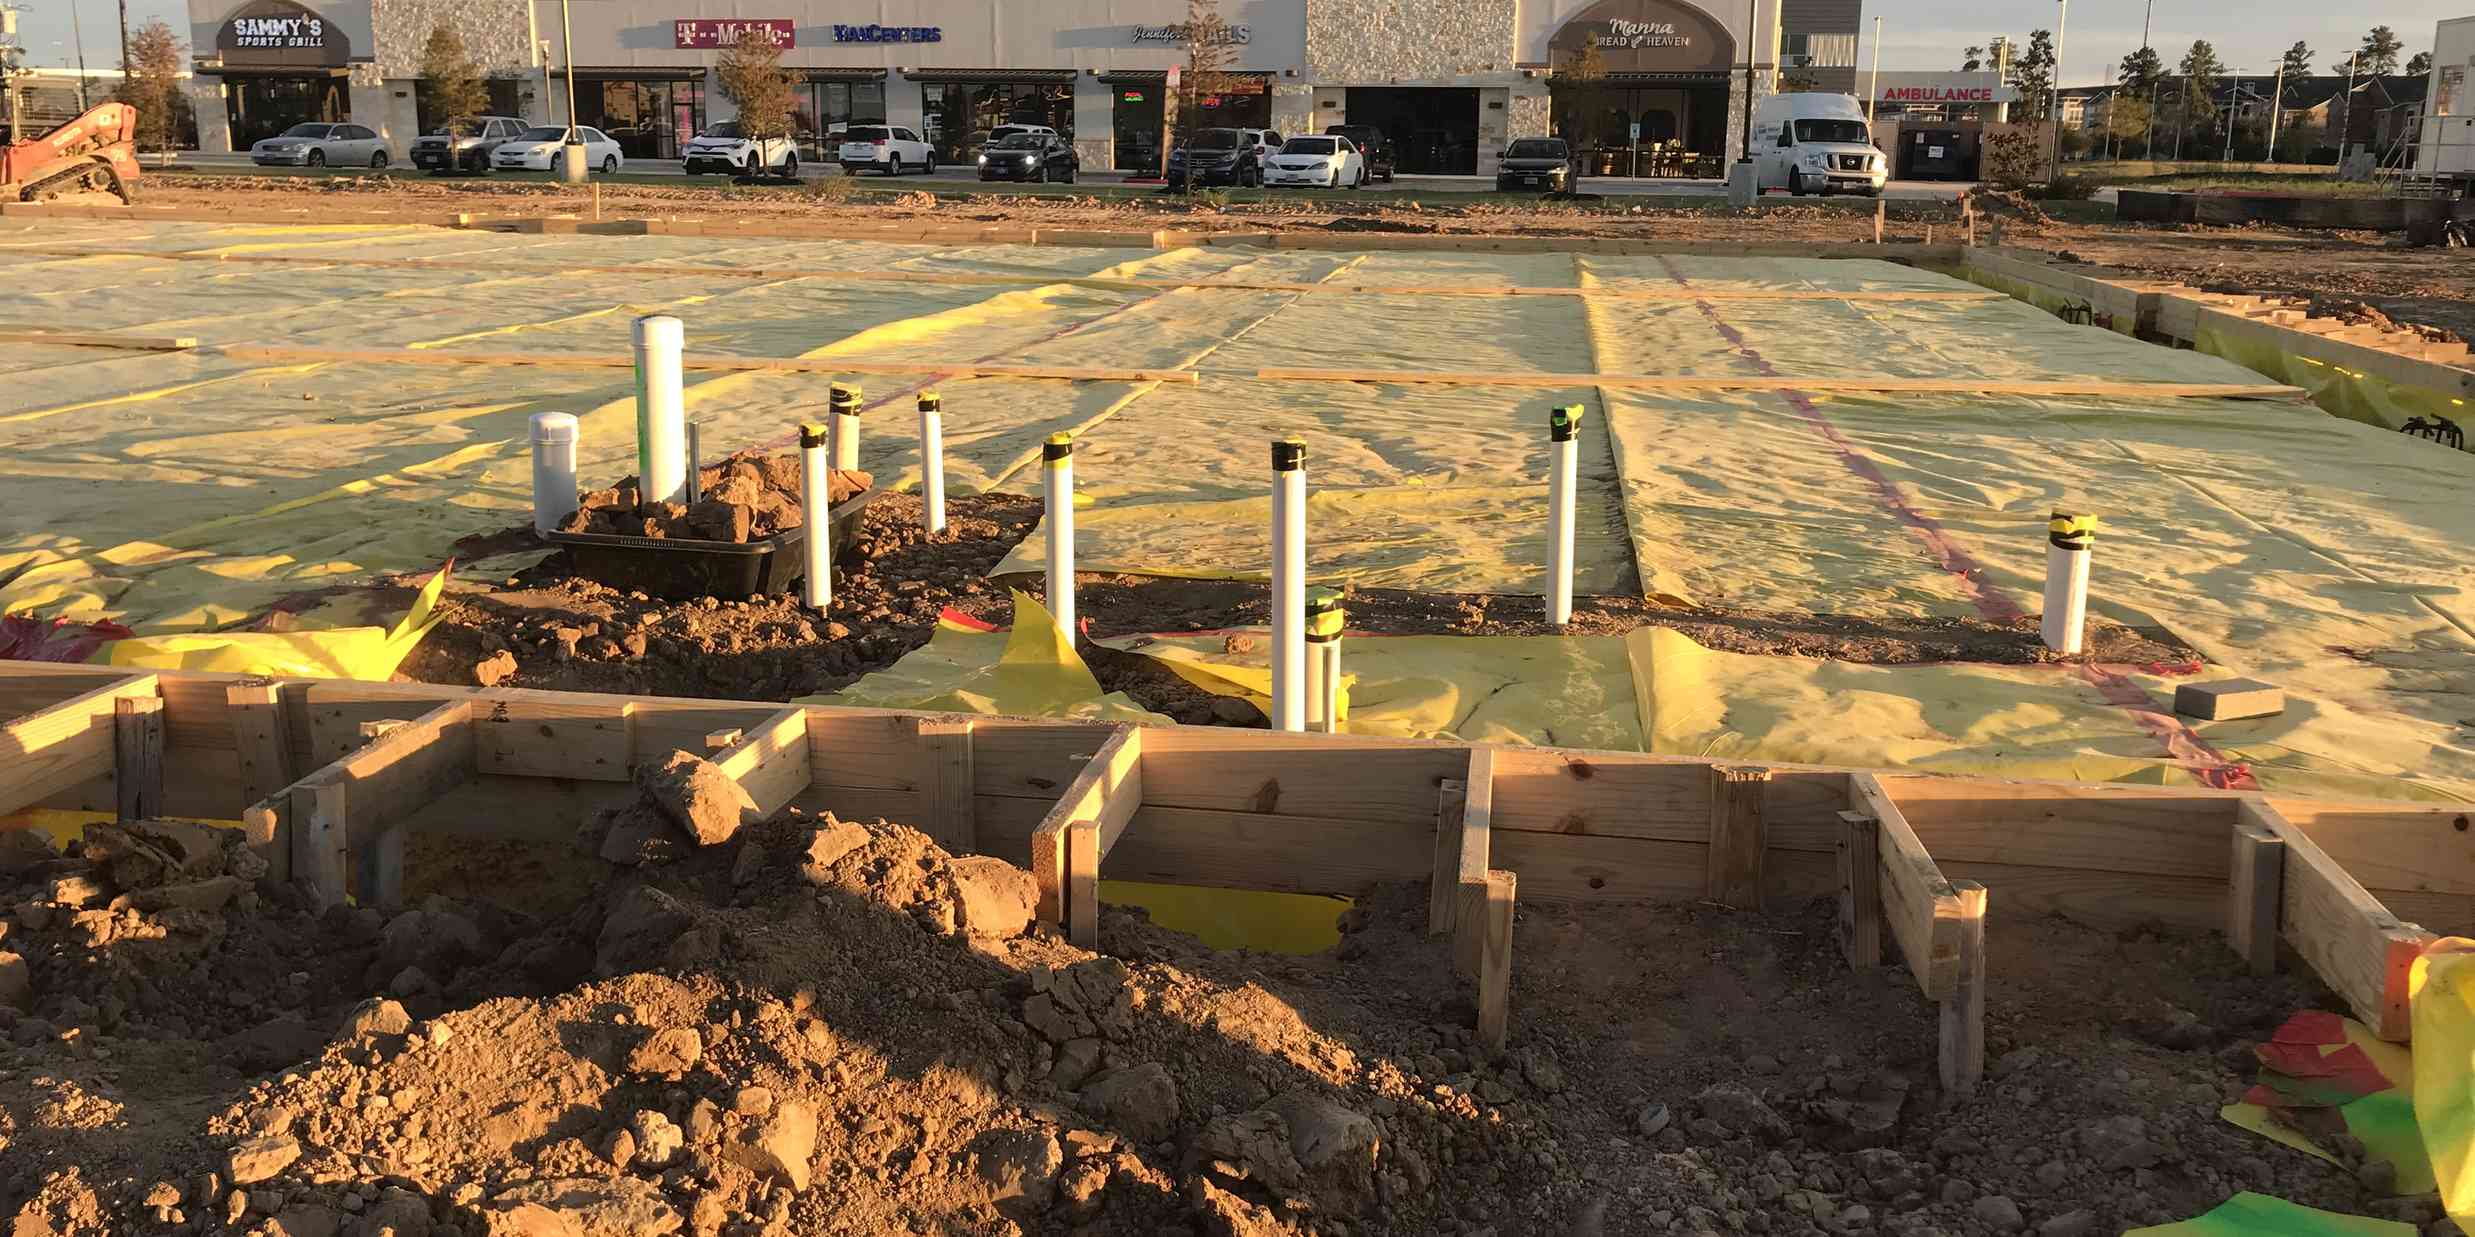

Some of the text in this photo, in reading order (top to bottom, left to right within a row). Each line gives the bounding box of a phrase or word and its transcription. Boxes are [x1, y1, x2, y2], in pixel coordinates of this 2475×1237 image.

[234, 13, 322, 36] SAMMY'S
[1610, 18, 1674, 36] Manna
[237, 37, 323, 46] SPORTS GRILL
[1647, 36, 1690, 47] HEAVEN
[1884, 87, 1993, 101] AMBULANCE
